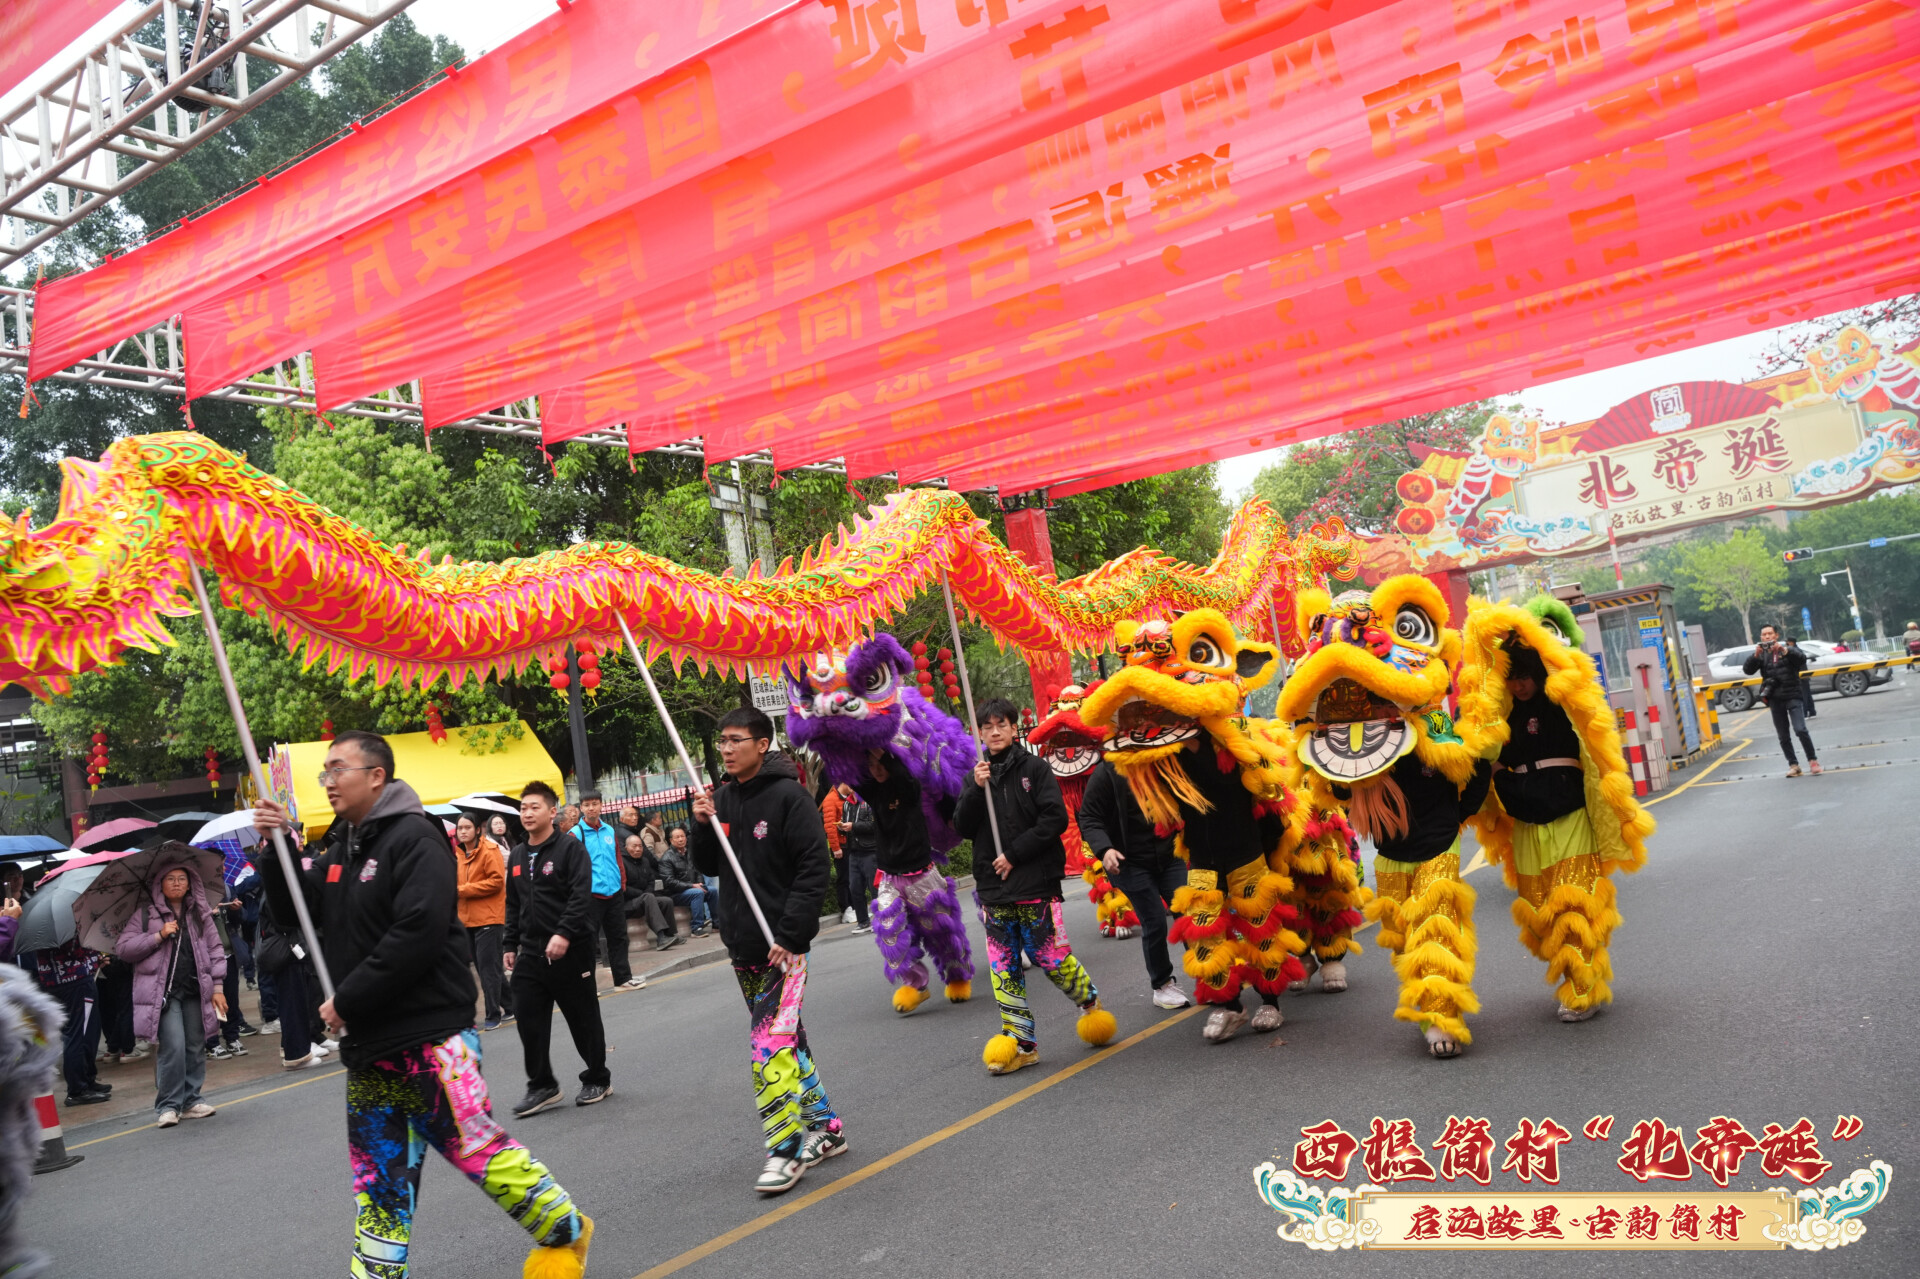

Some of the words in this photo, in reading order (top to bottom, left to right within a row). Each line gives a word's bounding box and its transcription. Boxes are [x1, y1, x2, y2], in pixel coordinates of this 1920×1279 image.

[1578, 417, 1793, 509] 北帝诞
[1610, 480, 1774, 530] 启沅故里·古韵简村
